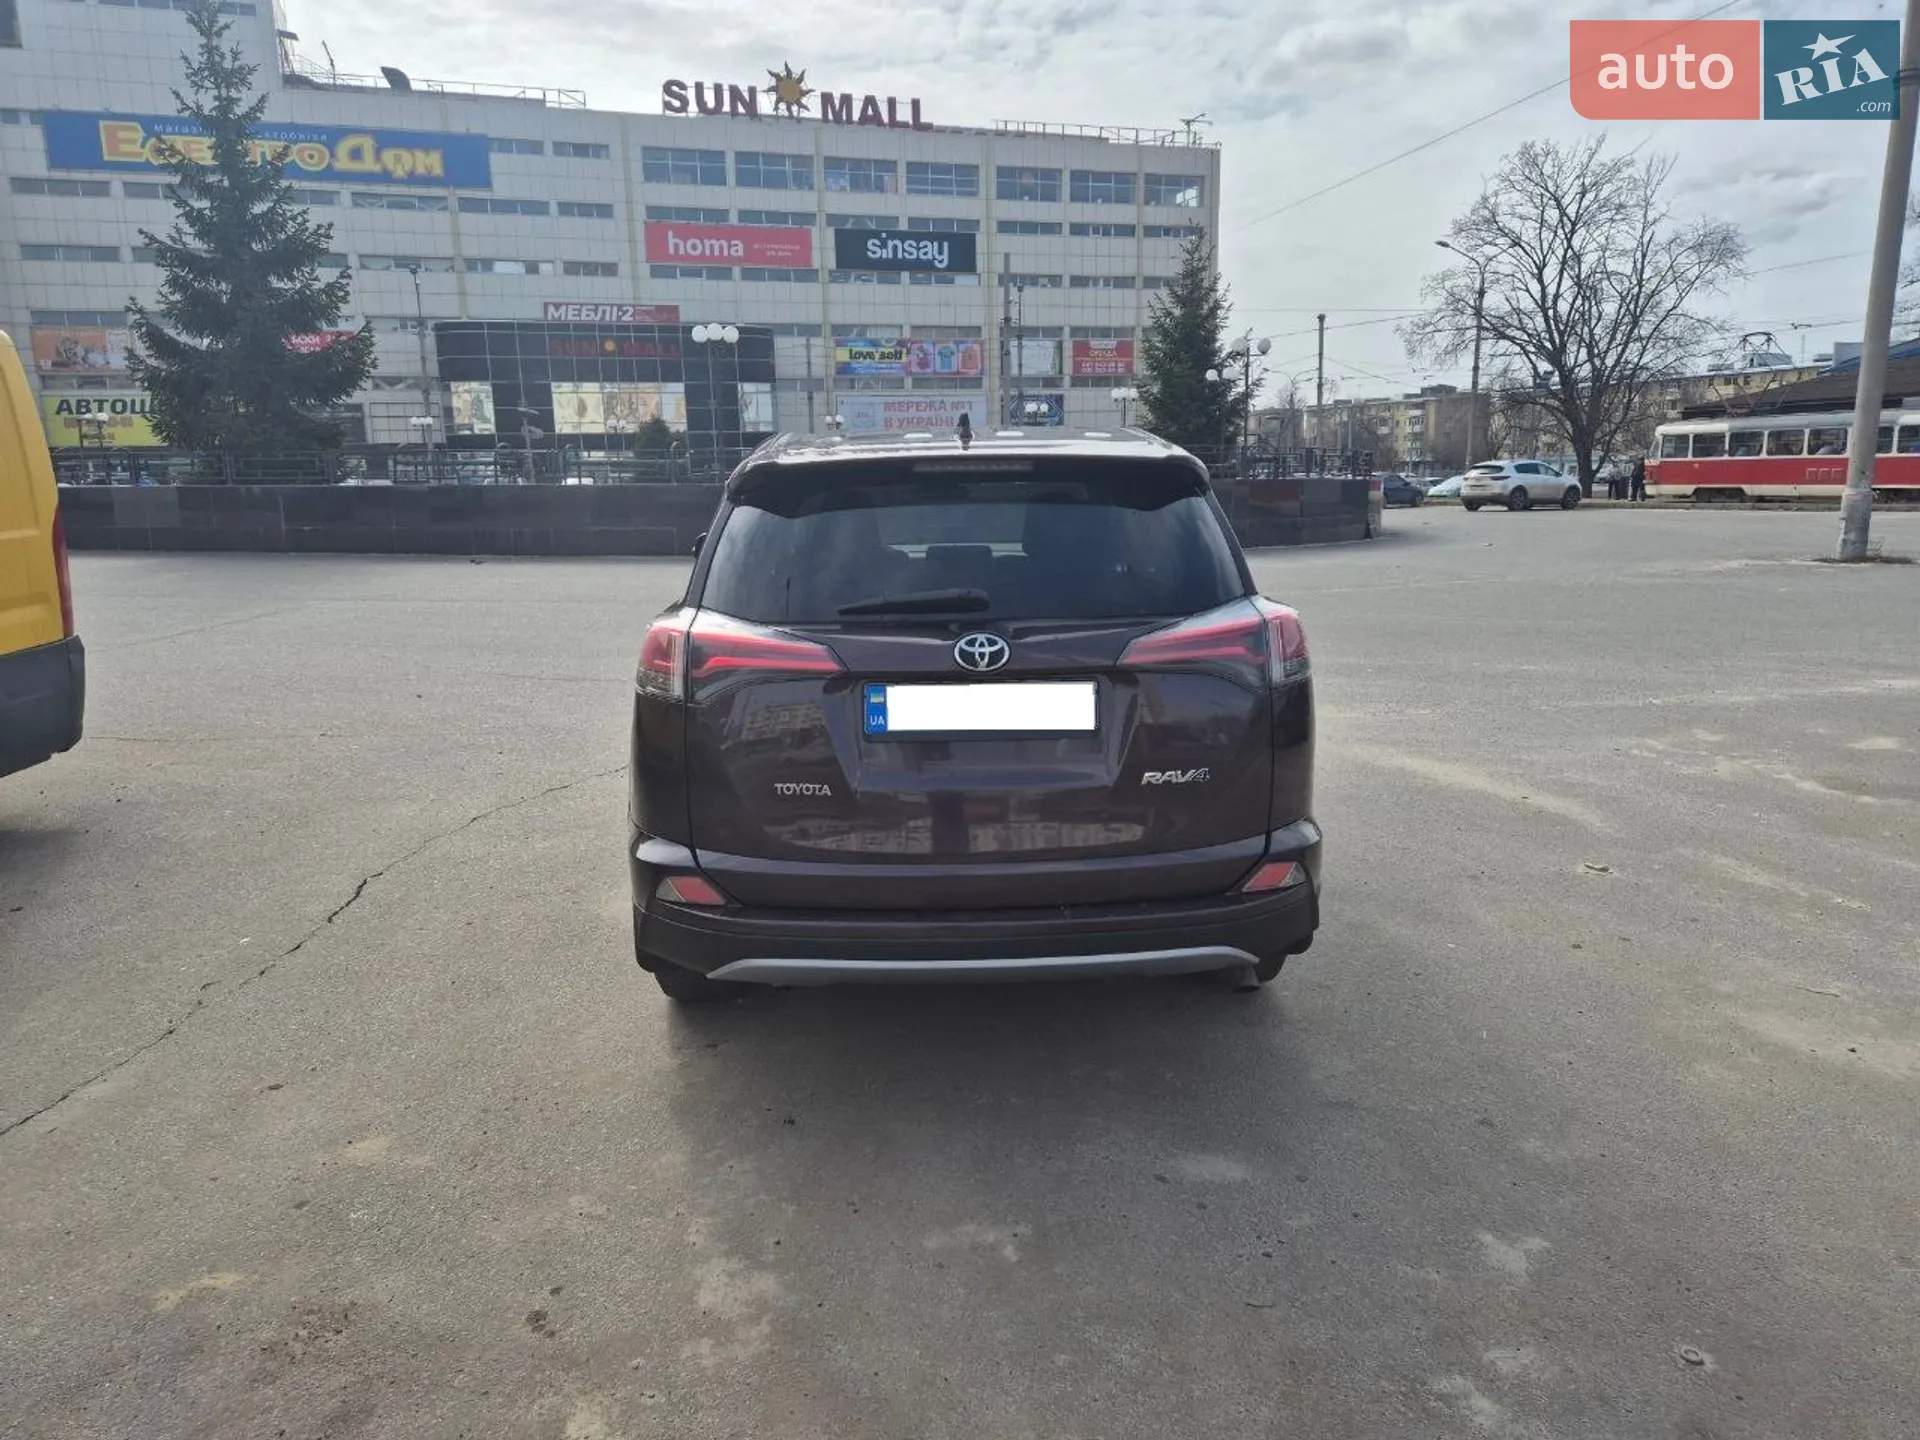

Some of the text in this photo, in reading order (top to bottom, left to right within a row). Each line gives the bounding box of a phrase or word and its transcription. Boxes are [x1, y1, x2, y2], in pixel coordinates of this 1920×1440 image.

[662, 79, 934, 132] SUN MALL
[668, 230, 744, 258] homa
[866, 232, 949, 268] sinsay
[55, 398, 153, 415] АВТОШ
[869, 715, 885, 726] UA
[1141, 767, 1210, 785] RAV4
[774, 782, 832, 797] TOYOTA
